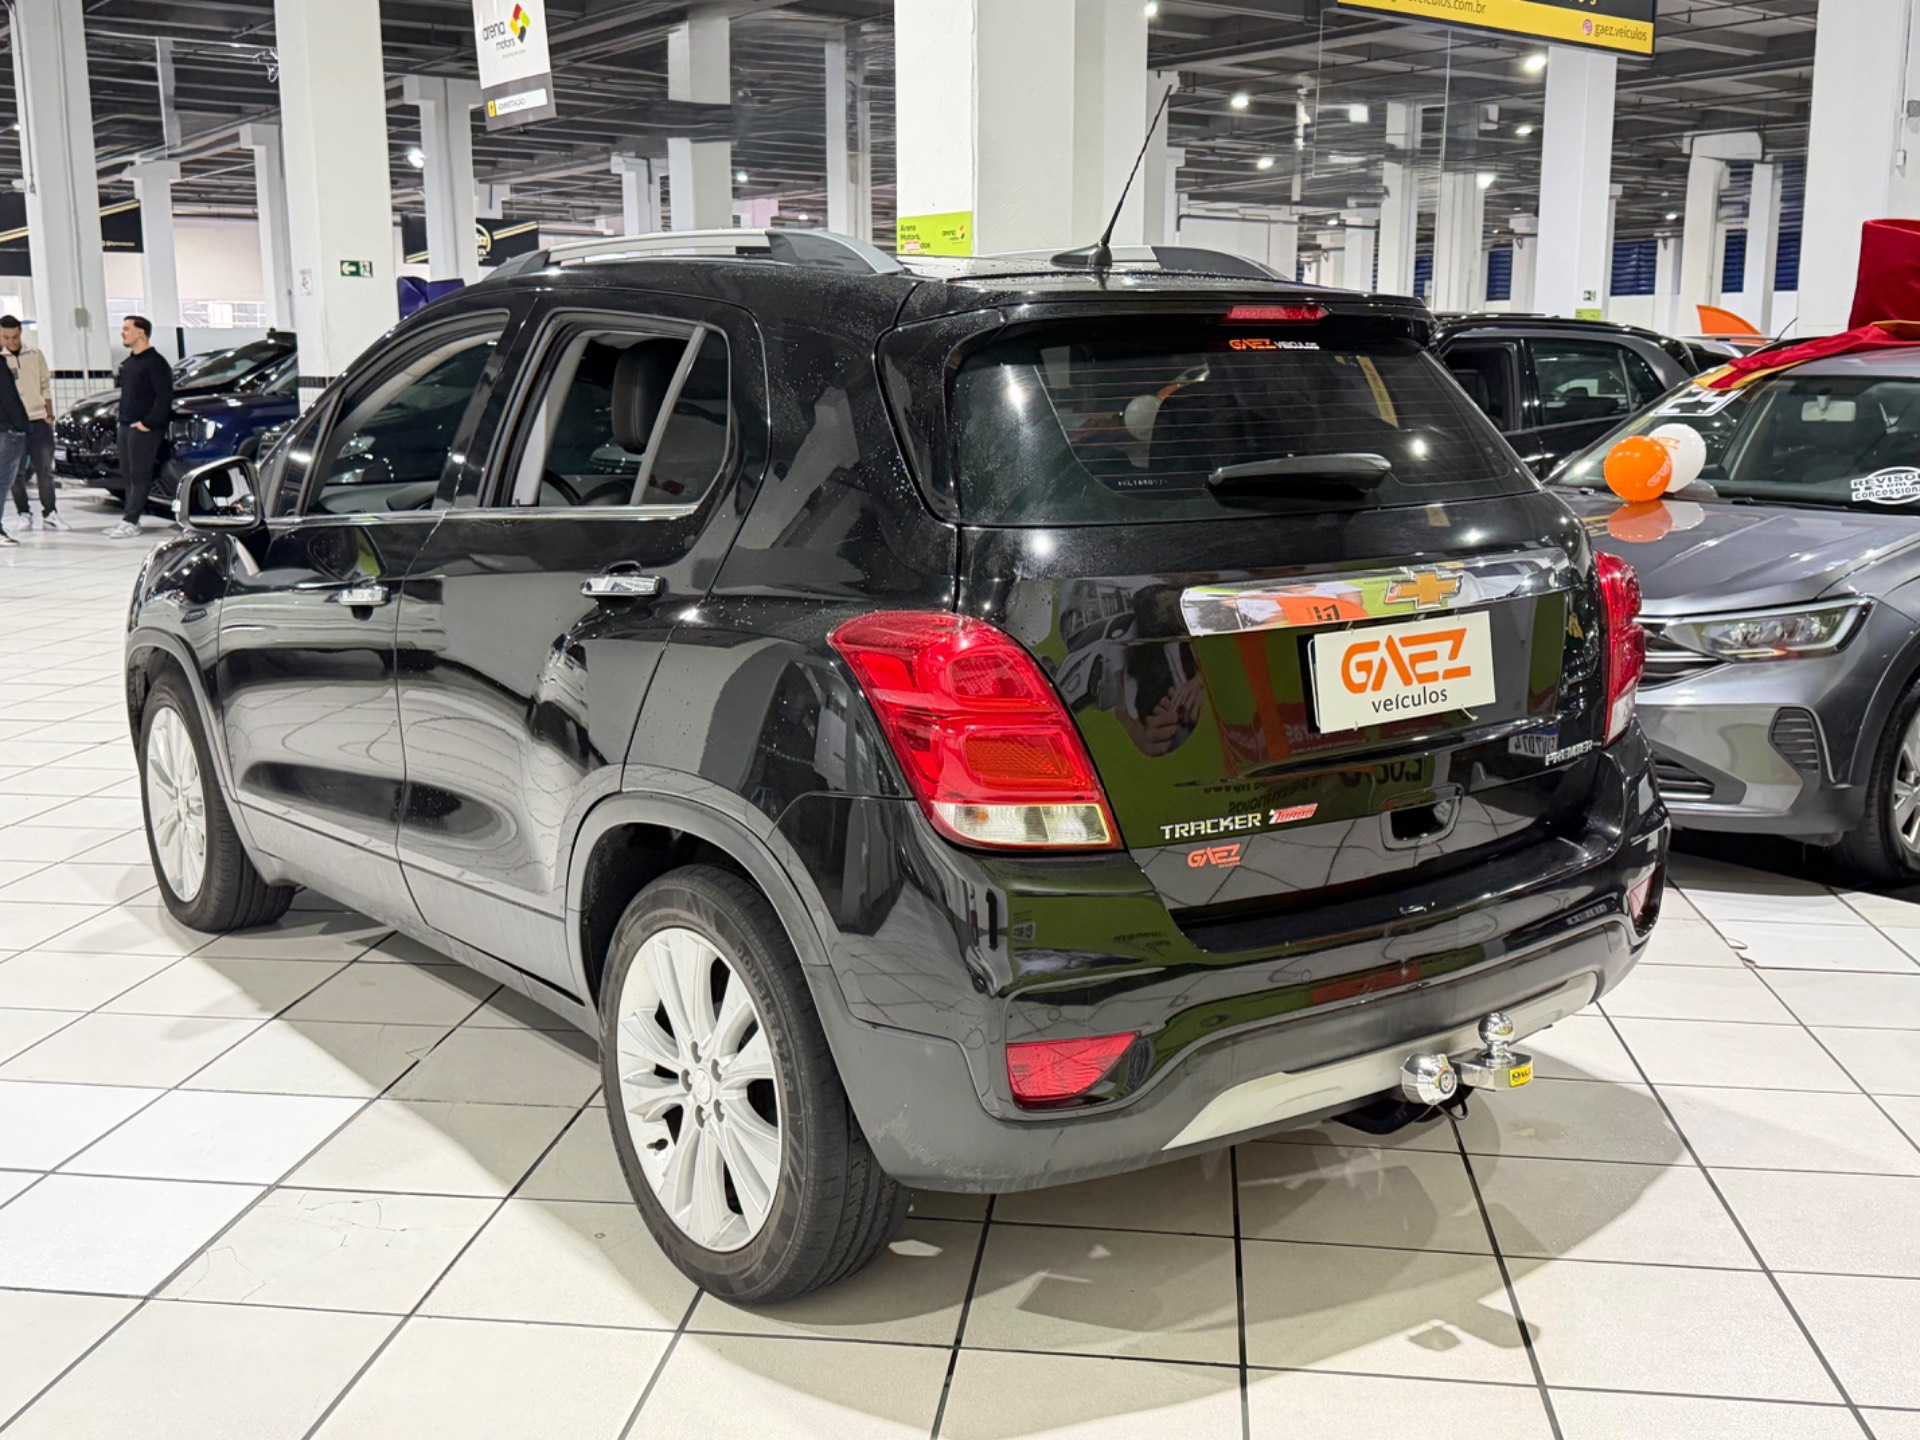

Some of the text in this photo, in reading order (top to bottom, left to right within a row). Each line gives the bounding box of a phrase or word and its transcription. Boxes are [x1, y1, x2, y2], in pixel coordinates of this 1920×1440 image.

[482, 21, 506, 41] arena
[1852, 472, 1920, 488] REVISO
[1341, 628, 1472, 694] GAEZ
[1371, 686, 1448, 713] veículos
[1160, 812, 1262, 840] TRACKER
[1187, 844, 1241, 868] GAEZ
